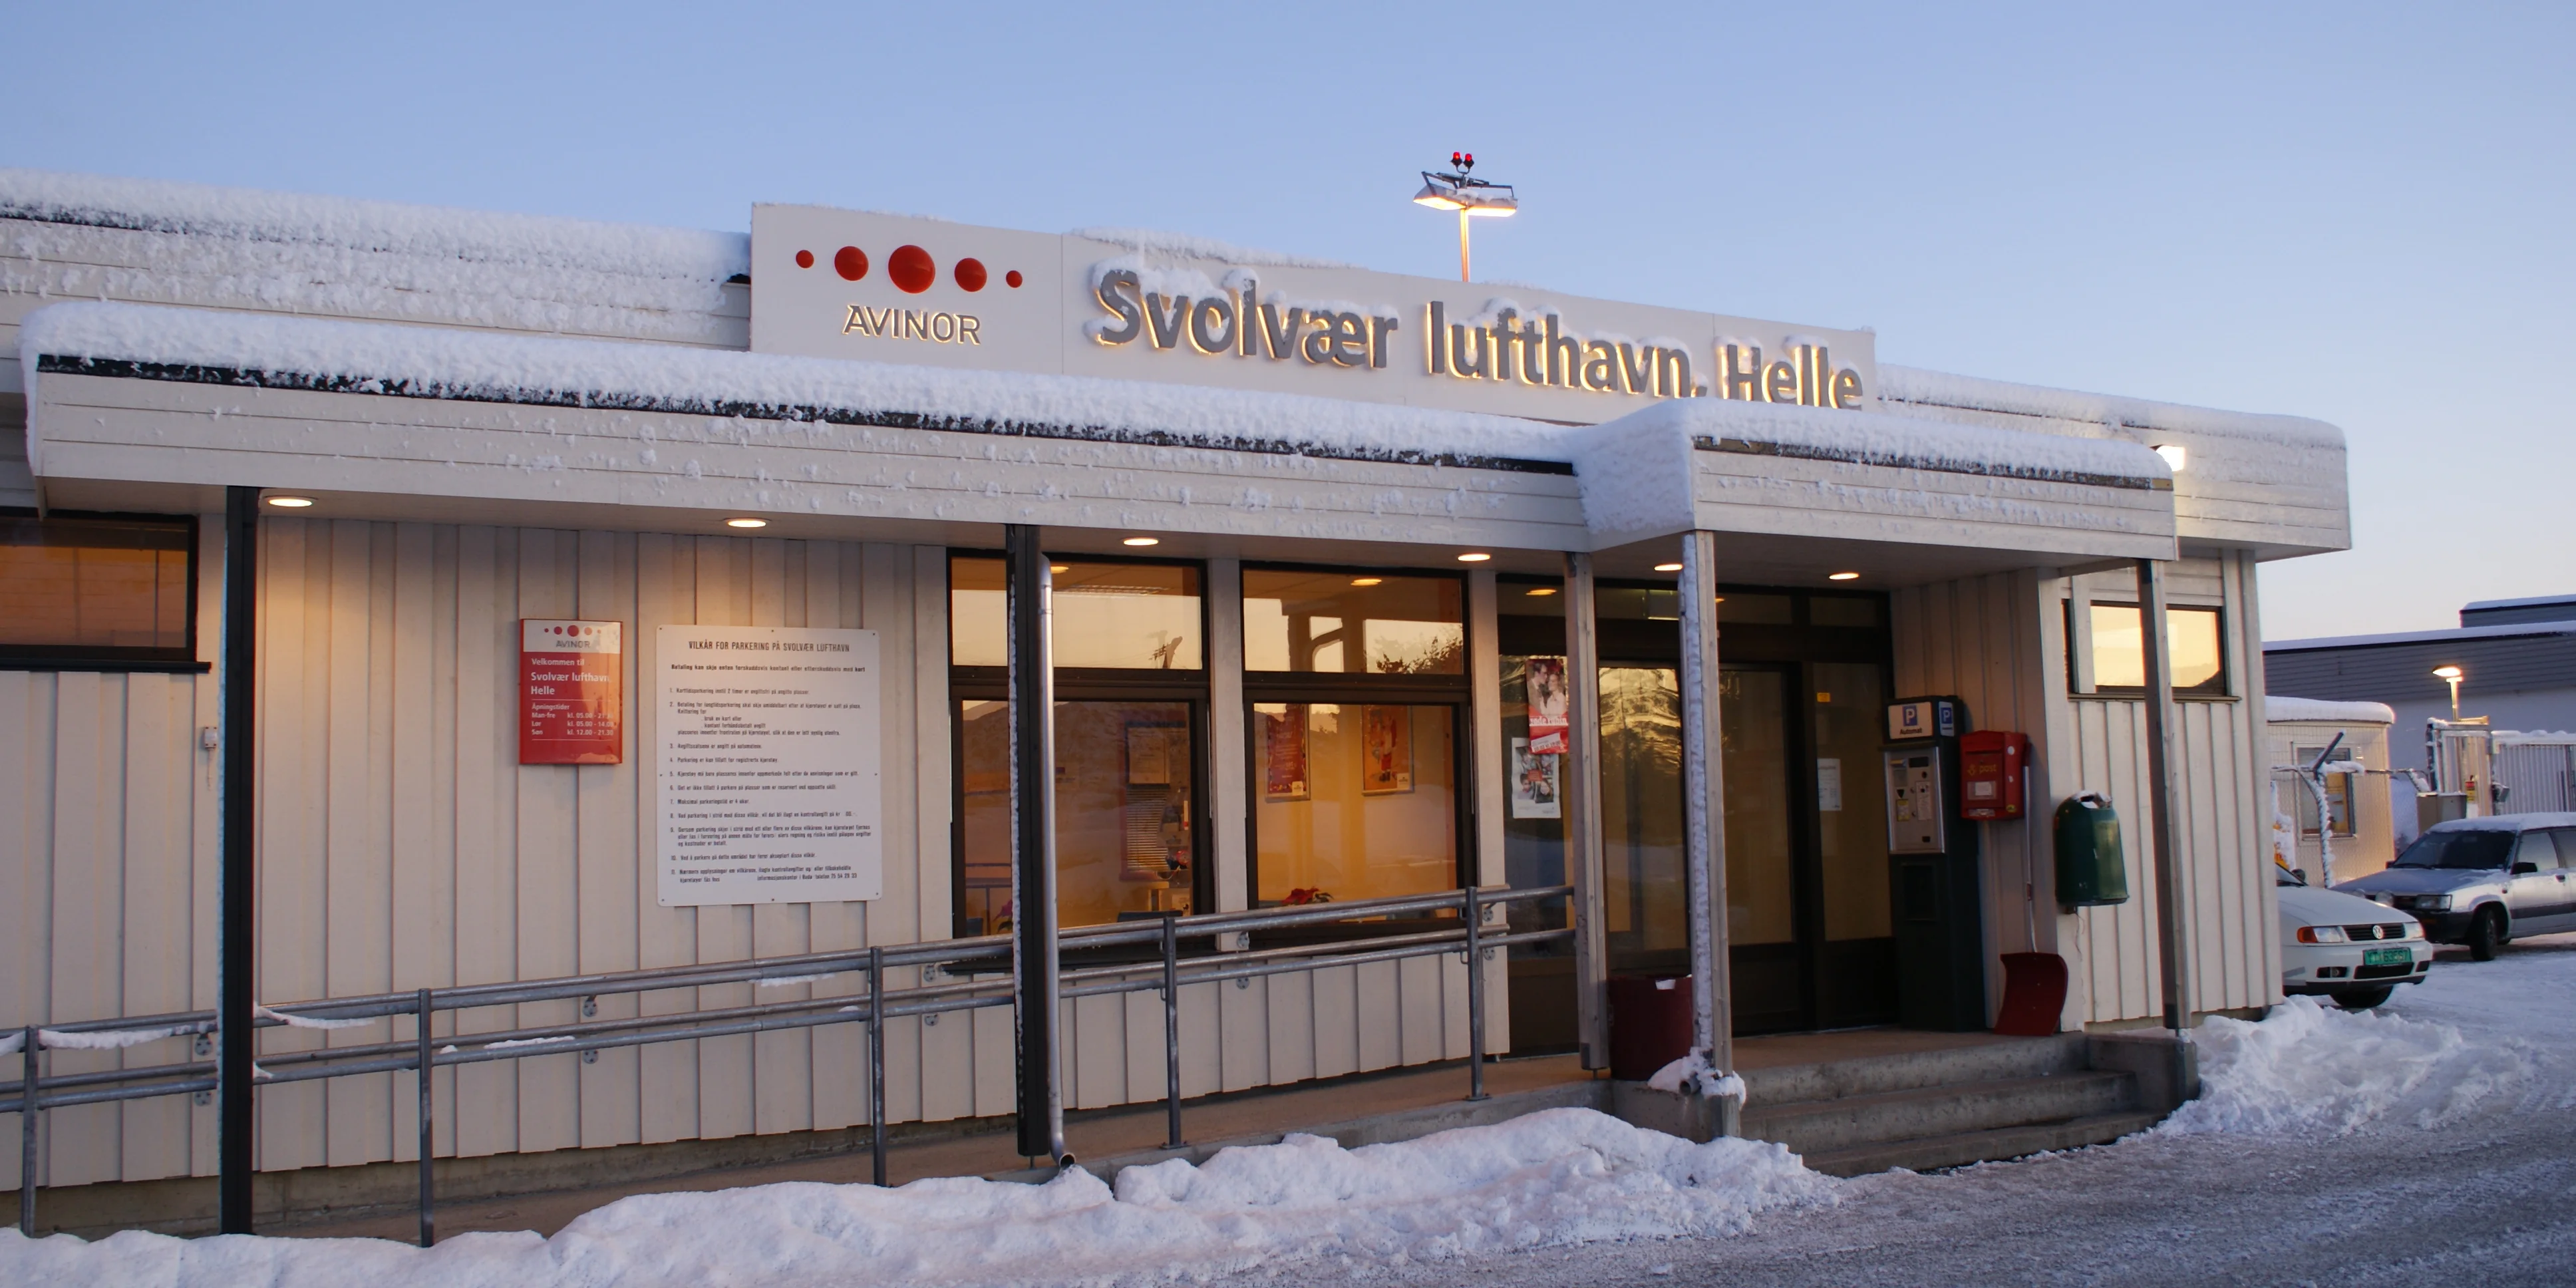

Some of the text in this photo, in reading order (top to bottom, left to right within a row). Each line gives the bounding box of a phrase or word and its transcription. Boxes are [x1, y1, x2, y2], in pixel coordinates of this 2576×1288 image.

[842, 305, 981, 345] AVINOR
[1098, 269, 1398, 368] Svolvær
[1722, 343, 1863, 409] Helle
[689, 639, 850, 652] VILKÅR FOR PARKERING PÅ SVOLVÆR LUFTHAVN
[531, 657, 575, 666] Velkommen
[531, 671, 569, 681] Svolvær
[531, 685, 556, 695] Helle
[532, 702, 570, 711] Åpningstider
[1905, 709, 1915, 724] P
[1943, 710, 1951, 722] P
[1899, 726, 1923, 735] Automat
[1979, 764, 1997, 774] post
